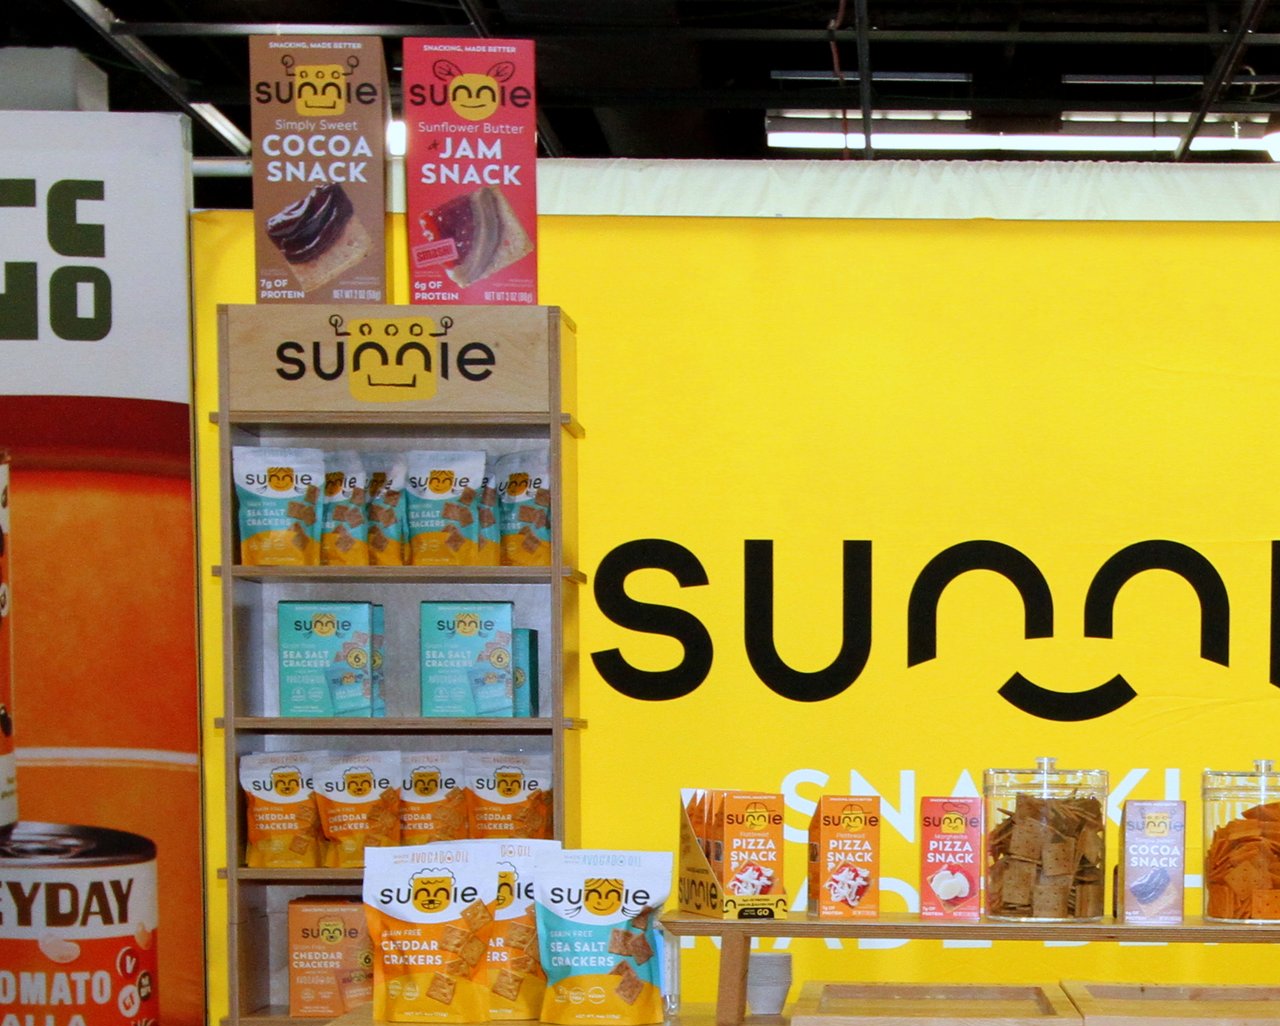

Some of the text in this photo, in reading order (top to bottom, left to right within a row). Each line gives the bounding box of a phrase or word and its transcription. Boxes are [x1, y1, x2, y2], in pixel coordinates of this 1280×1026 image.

[255, 81, 378, 104] sunnie
[409, 84, 532, 108] sunnie
[275, 119, 358, 132] Simply Sweet
[418, 121, 524, 135] Sunflower Butter
[262, 134, 373, 157] COCOA
[439, 137, 502, 160] JAM
[267, 161, 368, 183] SNACK
[421, 163, 522, 186] SNACK
[260, 279, 288, 289] 7g OF
[414, 281, 443, 290] 6g OF
[260, 289, 305, 299] PROTEIN
[414, 292, 459, 300] PROTEIN
[276, 340, 496, 381] sunnie
[245, 472, 313, 485] sunnie
[409, 476, 470, 488] sunnie
[263, 509, 286, 517] SALT
[246, 518, 291, 526] CRACKERS
[294, 620, 352, 631] sunnie
[437, 620, 495, 631] sunnie
[282, 650, 329, 659] SEA SALT
[425, 650, 472, 659] SEA SALT
[282, 660, 331, 668] CRACKERS
[325, 777, 390, 792] sunnie
[476, 778, 539, 791] sunnie
[726, 814, 783, 825] sunnie
[823, 815, 879, 827] sunnie
[923, 815, 980, 828] sunnie
[732, 838, 776, 849] PIZZA
[829, 840, 872, 850] PIZZA
[929, 840, 974, 851] PIZZA
[1128, 844, 1181, 856] COCOA
[730, 851, 777, 861] SNACK
[826, 852, 873, 863] SNACK
[926, 853, 974, 863] SNACK
[1130, 856, 1178, 867] SNACK
[380, 885, 478, 905] sunnie
[550, 887, 650, 906] sunnie
[0, 879, 135, 928] YDAY
[550, 930, 593, 938] GRAIN FREE
[381, 940, 439, 951] CHEDDAR
[550, 941, 606, 953] SEA SALT
[293, 951, 343, 960] CHEDDAR
[383, 954, 443, 966] CRACKERS
[293, 961, 341, 969] CRACKERS
[551, 956, 615, 967] CRACKERS
[0, 970, 112, 1006] OMATO
